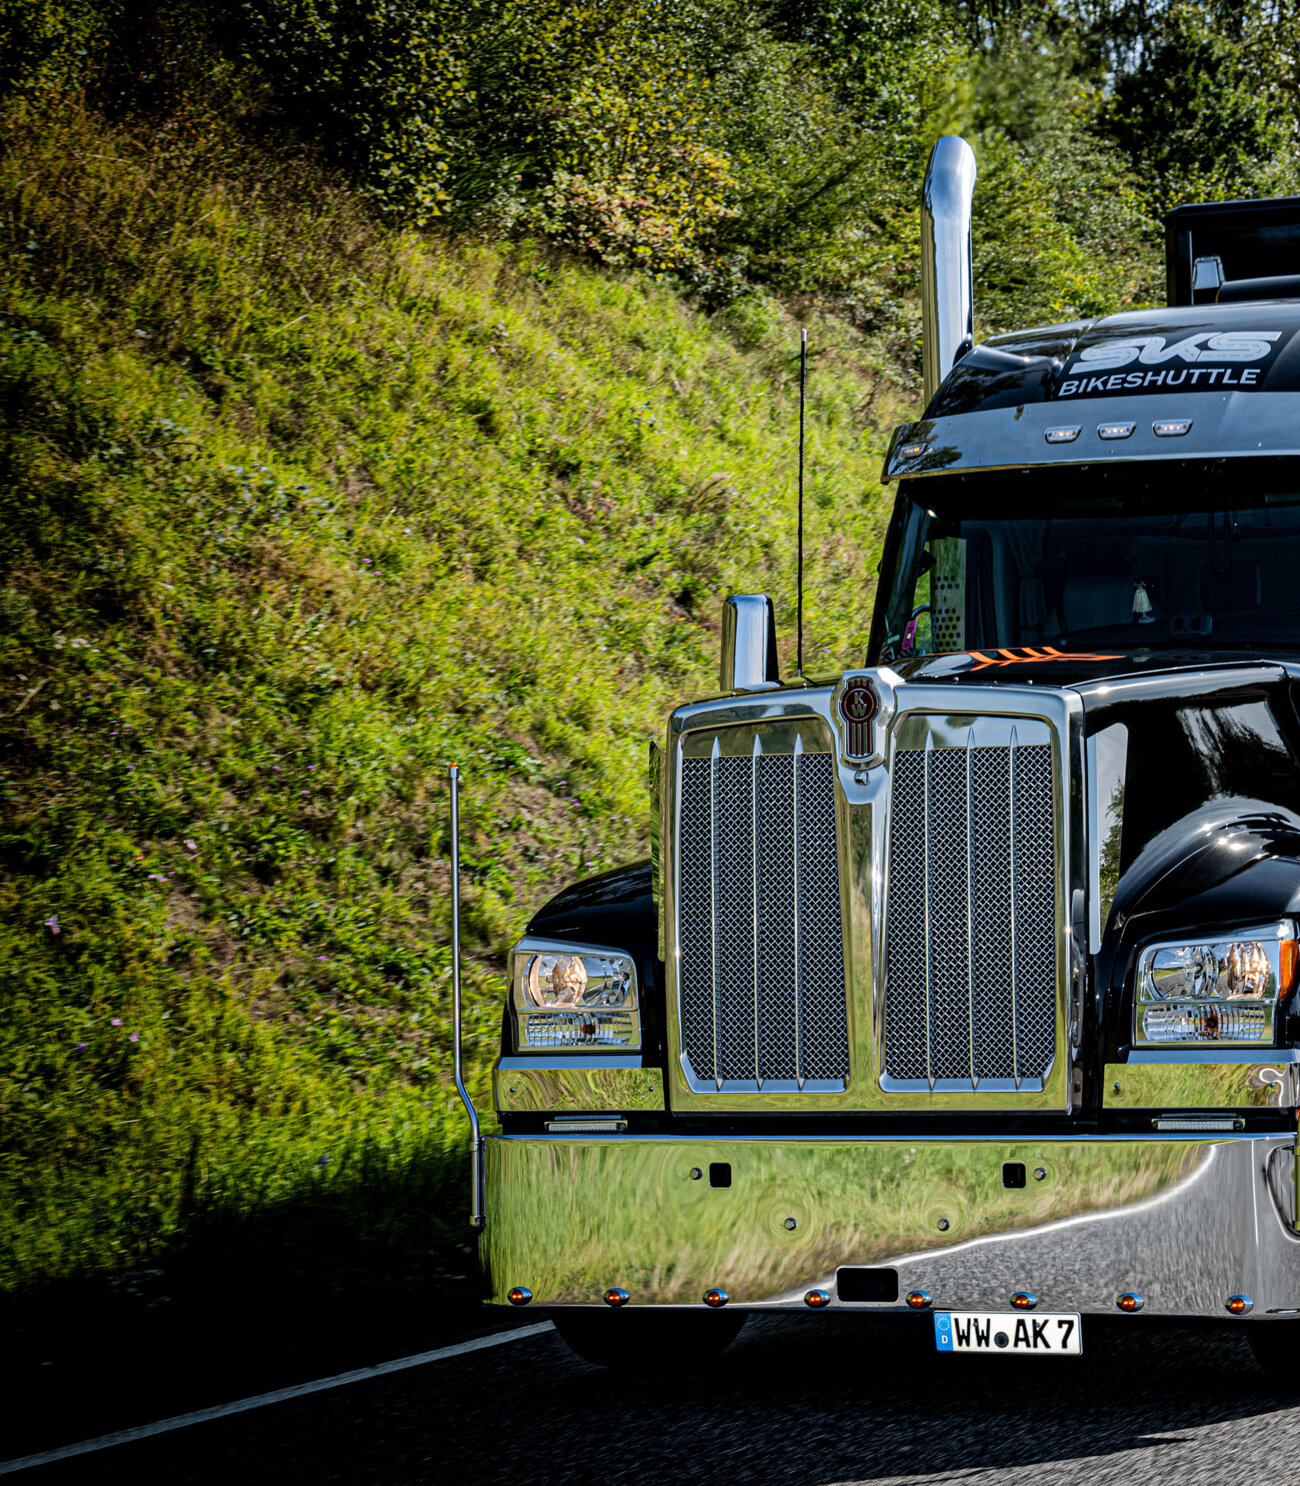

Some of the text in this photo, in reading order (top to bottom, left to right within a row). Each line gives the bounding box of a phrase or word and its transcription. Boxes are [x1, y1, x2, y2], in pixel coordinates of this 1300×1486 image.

[1069, 331, 1282, 375] SKS
[1058, 368, 1261, 397] BIKESHUTTLE
[941, 1317, 1075, 1349] D WW AK 7
